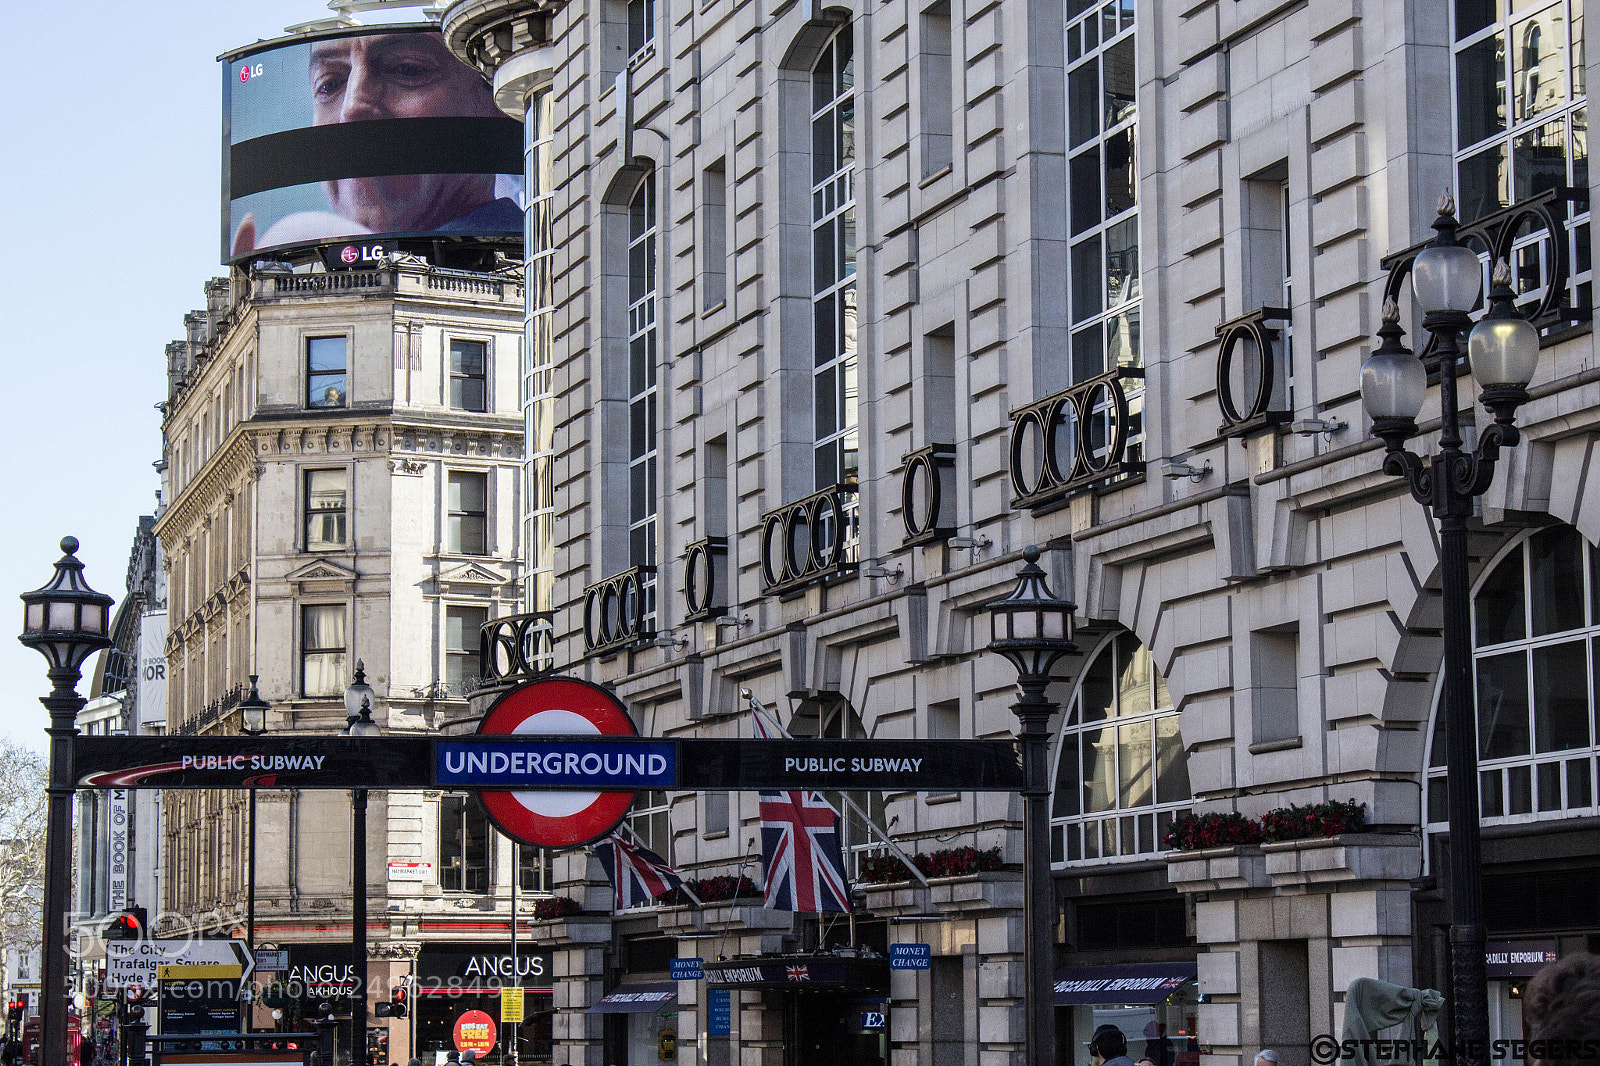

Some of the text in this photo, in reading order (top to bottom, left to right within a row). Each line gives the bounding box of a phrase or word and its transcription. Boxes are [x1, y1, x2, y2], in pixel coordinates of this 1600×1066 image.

[250, 63, 263, 78] LG
[361, 245, 383, 261] LG
[181, 755, 326, 770] PUBLIC SUBWAY
[445, 751, 667, 776] UNDERGROUND
[784, 757, 923, 772] PUBLIC SUBWAY
[113, 805, 126, 826] OF
[112, 830, 125, 874] BOOK
[112, 944, 166, 957] The City
[894, 947, 927, 955] MONEY
[1510, 951, 1544, 963] EMPORIUM
[464, 956, 544, 976] ANGUS
[892, 959, 929, 967] CHANGE
[111, 972, 144, 984] Hyde
[672, 970, 703, 979] CHANGE
[722, 967, 764, 983] EMPORIUM
[1104, 977, 1168, 991] EMPORIUM
[460, 1029, 489, 1040] FREE
